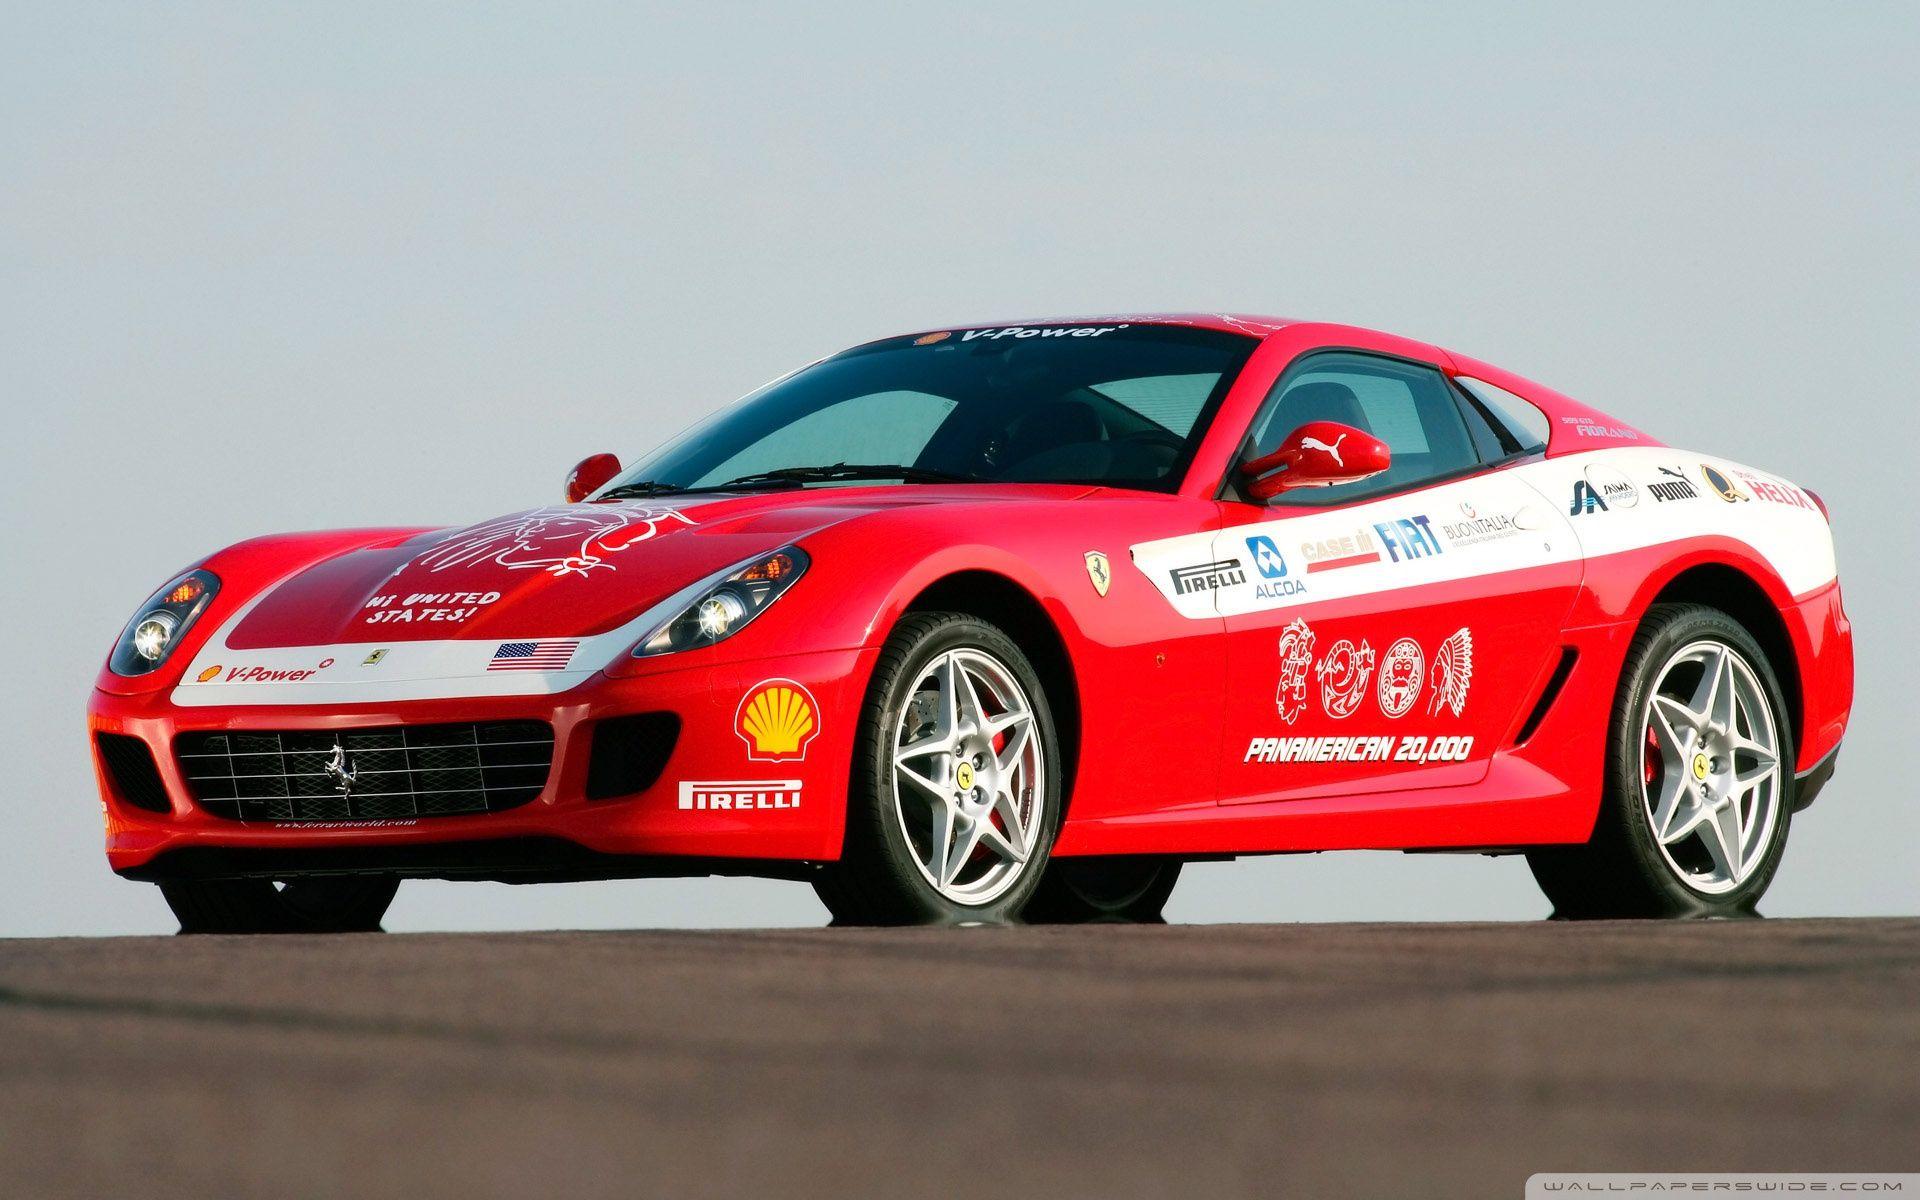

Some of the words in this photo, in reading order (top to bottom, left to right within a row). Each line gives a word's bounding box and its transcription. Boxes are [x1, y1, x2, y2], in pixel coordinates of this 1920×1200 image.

[960, 325, 1117, 342] V-Power
[1647, 482, 1698, 502] PUMA
[1743, 480, 1815, 511] HELIX
[1443, 514, 1513, 541] BUONITALIA
[1301, 536, 1353, 561] CASE
[1373, 514, 1443, 564] FIAT
[1169, 558, 1247, 595] PIRELLI
[402, 591, 501, 607] UNITED
[1256, 580, 1307, 600] ALCOA
[366, 607, 478, 623] STATES!
[225, 666, 316, 682] V-Power
[1243, 736, 1396, 764] PANAMERICAN
[1393, 736, 1475, 765] 20,000
[678, 780, 803, 810] PIRELLI
[275, 819, 417, 829] www.ferrariworld.com
